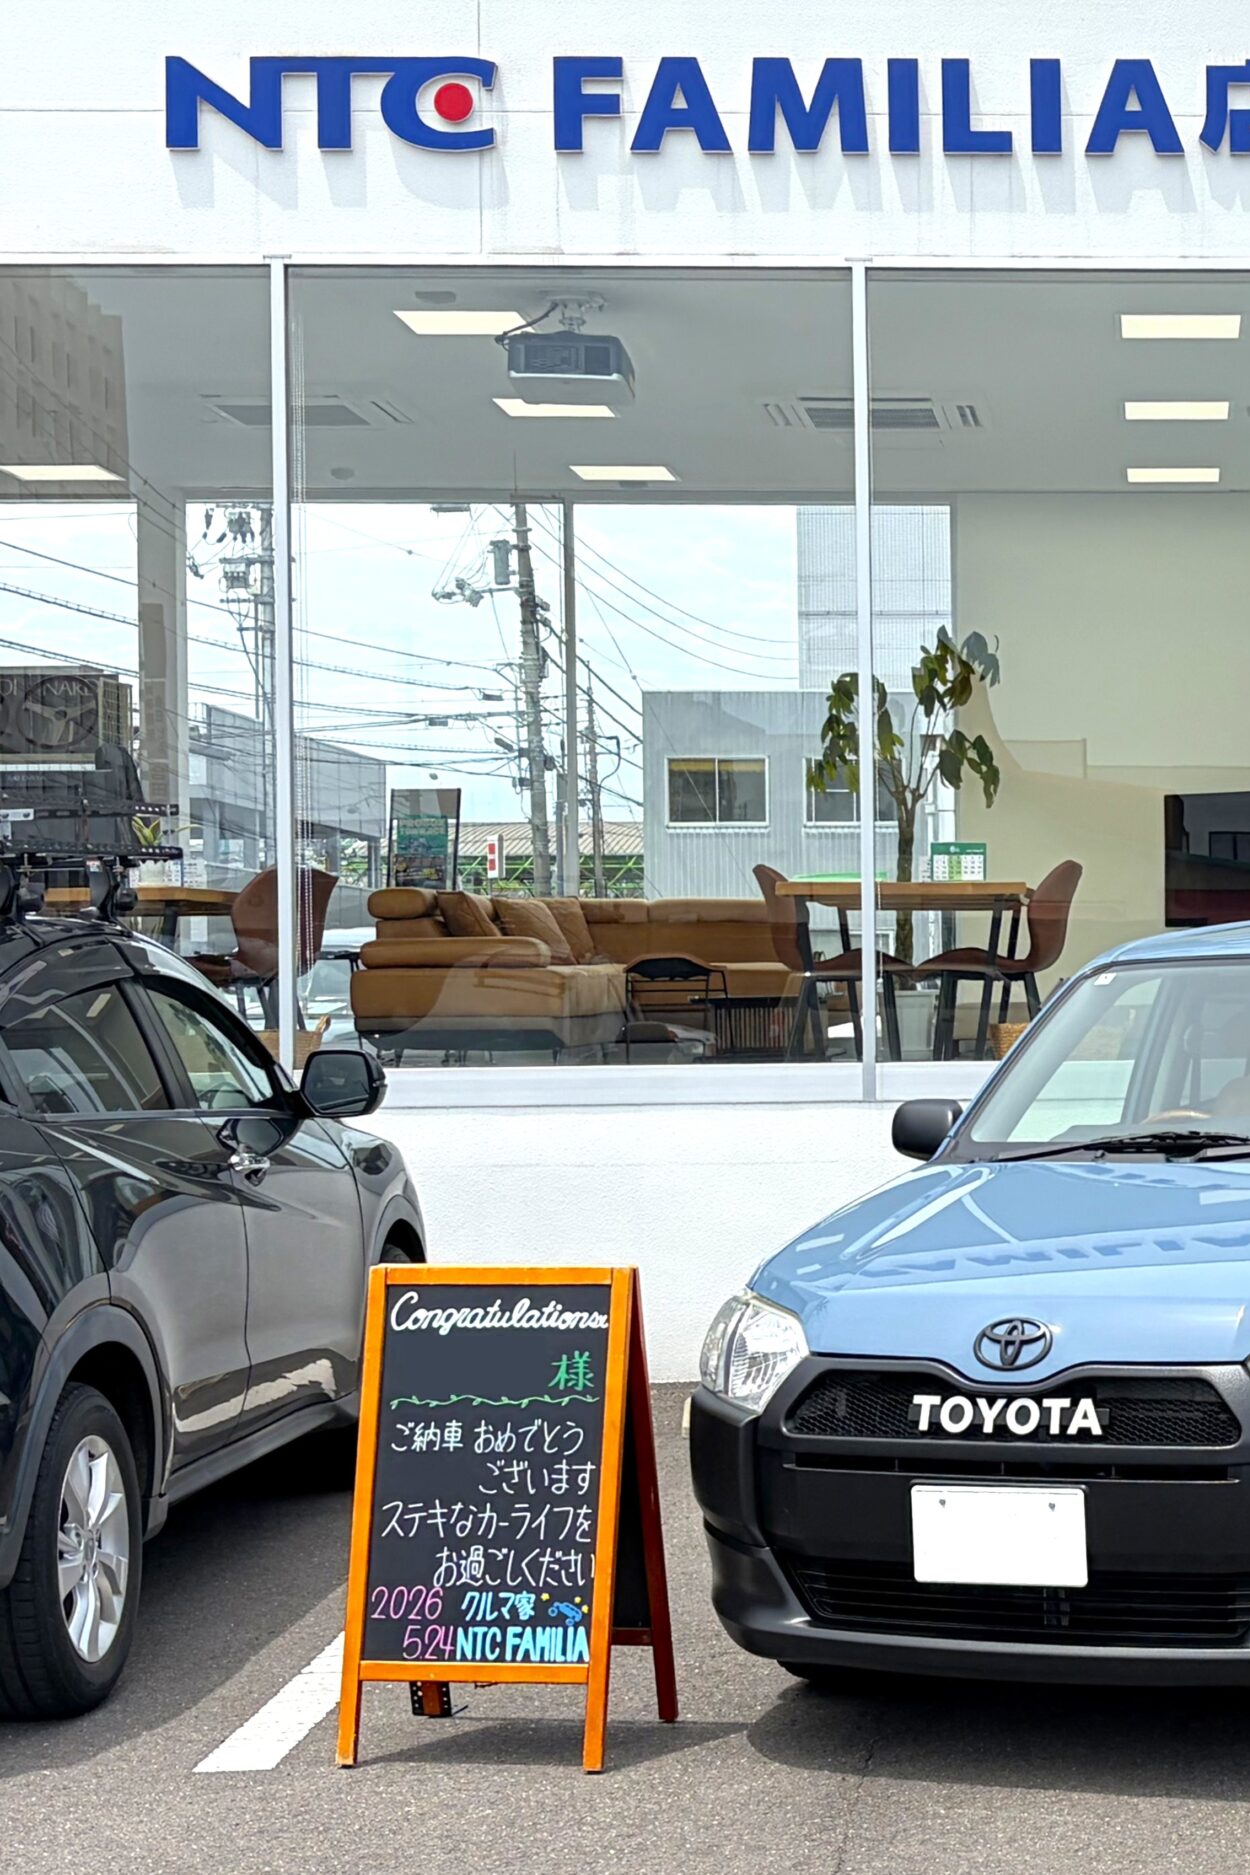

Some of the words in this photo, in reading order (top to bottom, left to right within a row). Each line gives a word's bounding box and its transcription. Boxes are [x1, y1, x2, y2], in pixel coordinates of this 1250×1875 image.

[165, 56, 497, 153] NTC
[547, 1350, 595, 1391] 様
[912, 1394, 1103, 1436] TOYOTA
[391, 1419, 464, 1452] ご納車
[474, 1418, 585, 1456] おめでとう
[478, 1459, 597, 1495] ございます
[381, 1499, 593, 1543] ステキなカーライフを
[432, 1545, 595, 1588] お過ごしください
[370, 1585, 443, 1620] 2026
[461, 1591, 536, 1622] クルマ家
[456, 1626, 501, 1661] NTC
[505, 1626, 590, 1662] FAMILIA
